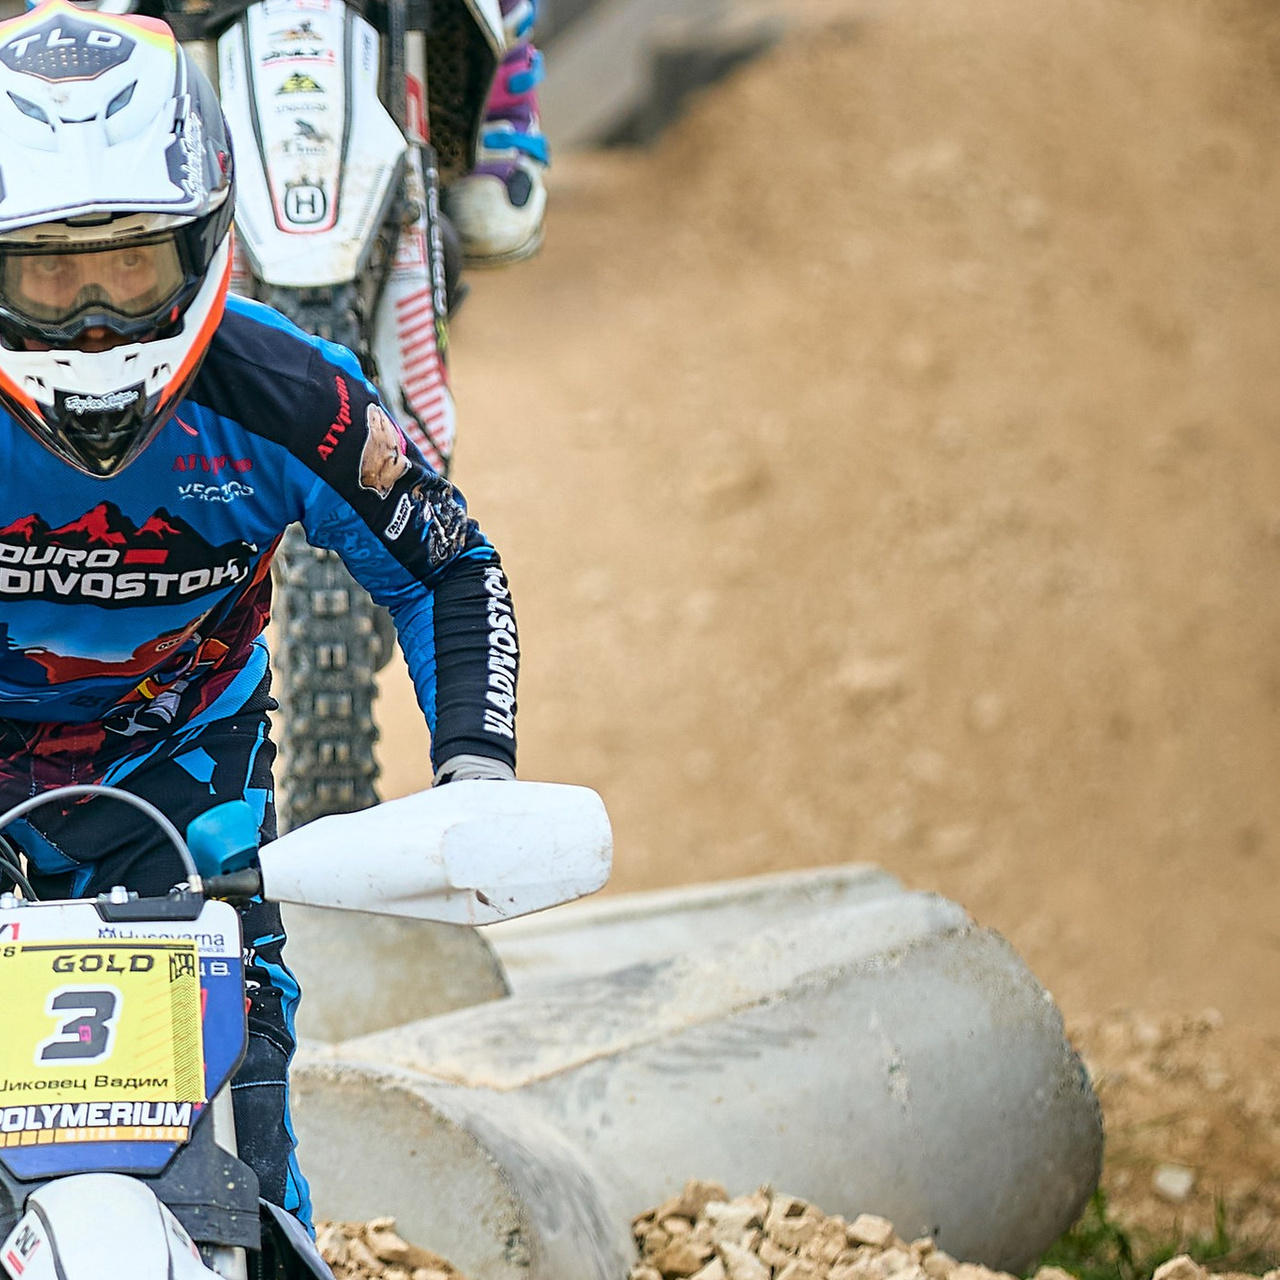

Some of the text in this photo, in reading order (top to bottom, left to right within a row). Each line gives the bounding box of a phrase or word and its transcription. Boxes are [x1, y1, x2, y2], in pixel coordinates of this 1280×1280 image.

[8, 27, 123, 58] TLD
[52, 954, 155, 976] GOLD
[41, 990, 117, 1060] 3
[95, 1074, 169, 1089] Вадим
